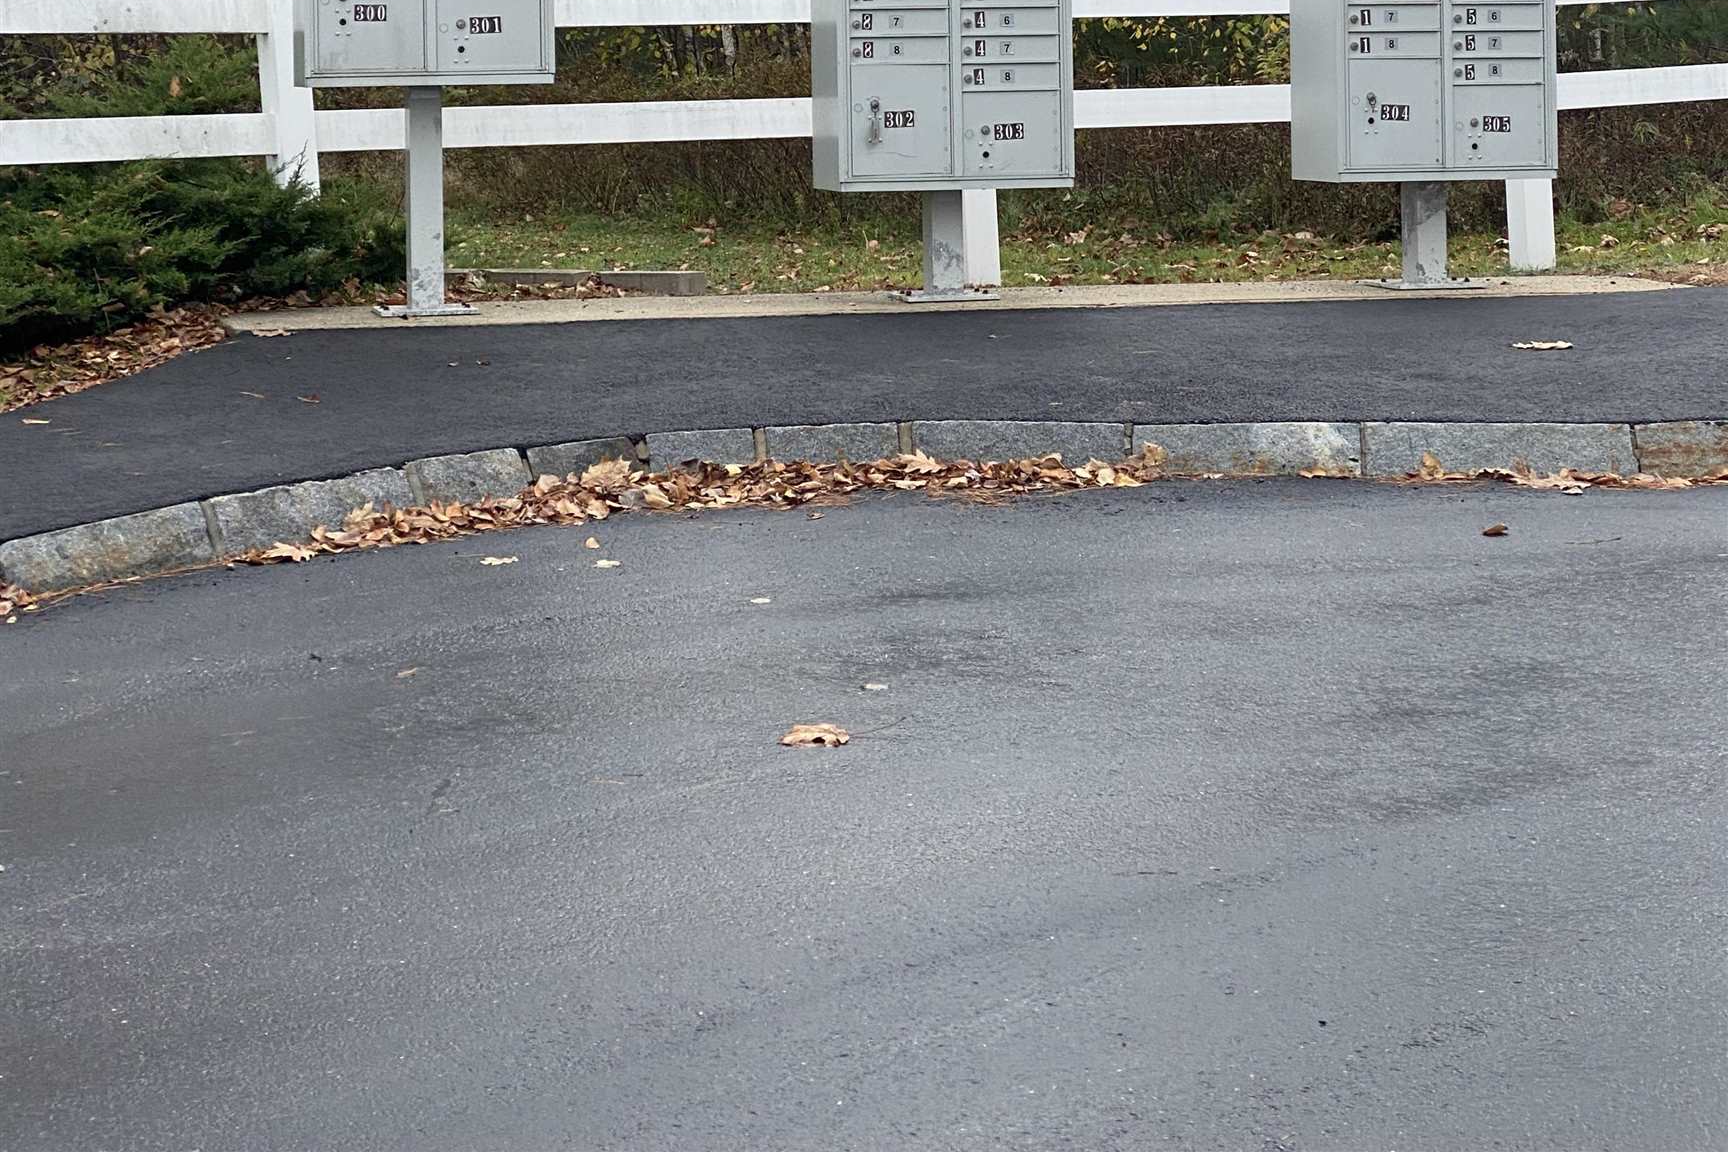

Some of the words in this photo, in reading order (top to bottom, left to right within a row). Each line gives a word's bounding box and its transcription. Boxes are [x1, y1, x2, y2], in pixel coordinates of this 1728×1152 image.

[356, 5, 386, 21] 300
[976, 12, 985, 28] 4
[1004, 16, 1010, 25] 6
[1362, 9, 1370, 25] 1
[1388, 13, 1394, 21] 7
[1467, 9, 1476, 24] 5
[1491, 11, 1497, 21] 6
[471, 18, 501, 33] 301
[863, 14, 871, 29] 8
[893, 17, 899, 26] 7
[864, 42, 872, 58] 8
[894, 46, 900, 55] 8
[976, 41, 985, 56] 4
[1004, 44, 1010, 53] 7
[1361, 38, 1369, 53] 1
[1388, 39, 1395, 48] 8
[1467, 35, 1475, 50] 5
[1492, 39, 1497, 48] 7
[975, 69, 984, 84] 4
[1004, 72, 1011, 81] 8
[1466, 64, 1475, 80] 5
[1492, 66, 1498, 75] 8
[886, 112, 914, 127] 302
[1382, 105, 1409, 120] 304
[996, 124, 1023, 139] 303
[1484, 116, 1510, 132] 305
